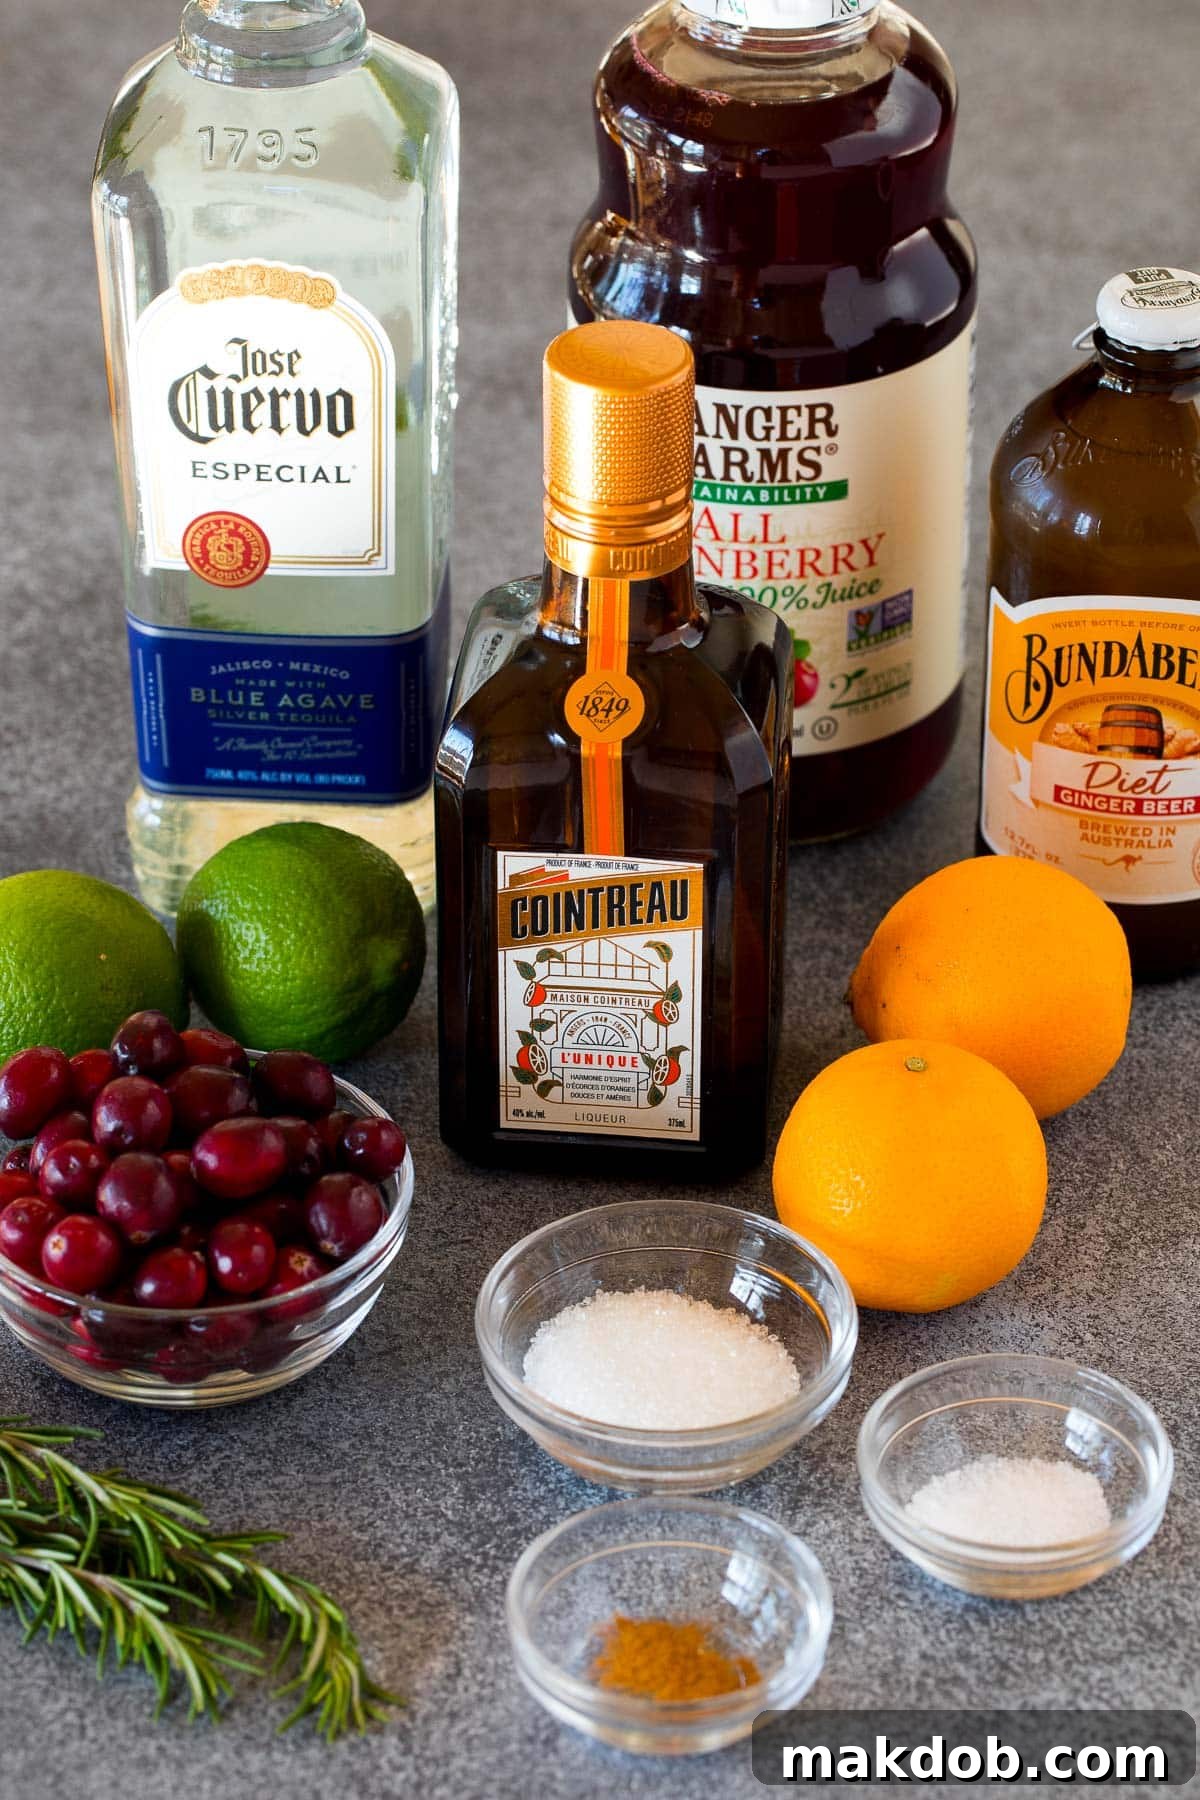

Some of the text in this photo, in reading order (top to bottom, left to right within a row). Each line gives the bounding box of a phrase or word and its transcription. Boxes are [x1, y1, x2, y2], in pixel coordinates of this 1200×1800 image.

[197, 125, 321, 168] 1795
[225, 337, 302, 384] Jose
[168, 364, 355, 445] Cuervo
[694, 402, 839, 442] ANGER
[191, 461, 352, 484] ESPECIAL
[694, 486, 827, 502] AINABILITY
[694, 532, 887, 580] NBERRY
[813, 577, 882, 609] Juice
[1092, 619, 1135, 628] BOTTLE
[1140, 621, 1186, 631] BEFORE
[211, 660, 351, 680] JALISCO MEXICO
[1005, 630, 1200, 724] BUNDABE
[235, 679, 327, 689] MADE WITH
[190, 687, 376, 709] BLUE AGAVE
[579, 695, 630, 718] 1849
[208, 708, 358, 723] SILVER TEQUILA
[1083, 761, 1193, 796] Diet
[1060, 789, 1196, 815] GINGER BEER
[1079, 819, 1176, 837] BREWED IN
[1080, 832, 1174, 849] AUSTRALIA
[510, 879, 689, 940] COINTREAU
[550, 994, 650, 1007] MAISON COINTREAU
[561, 1052, 639, 1068] L'UNIQUE
[574, 1113, 627, 1124] LIQUEUR
